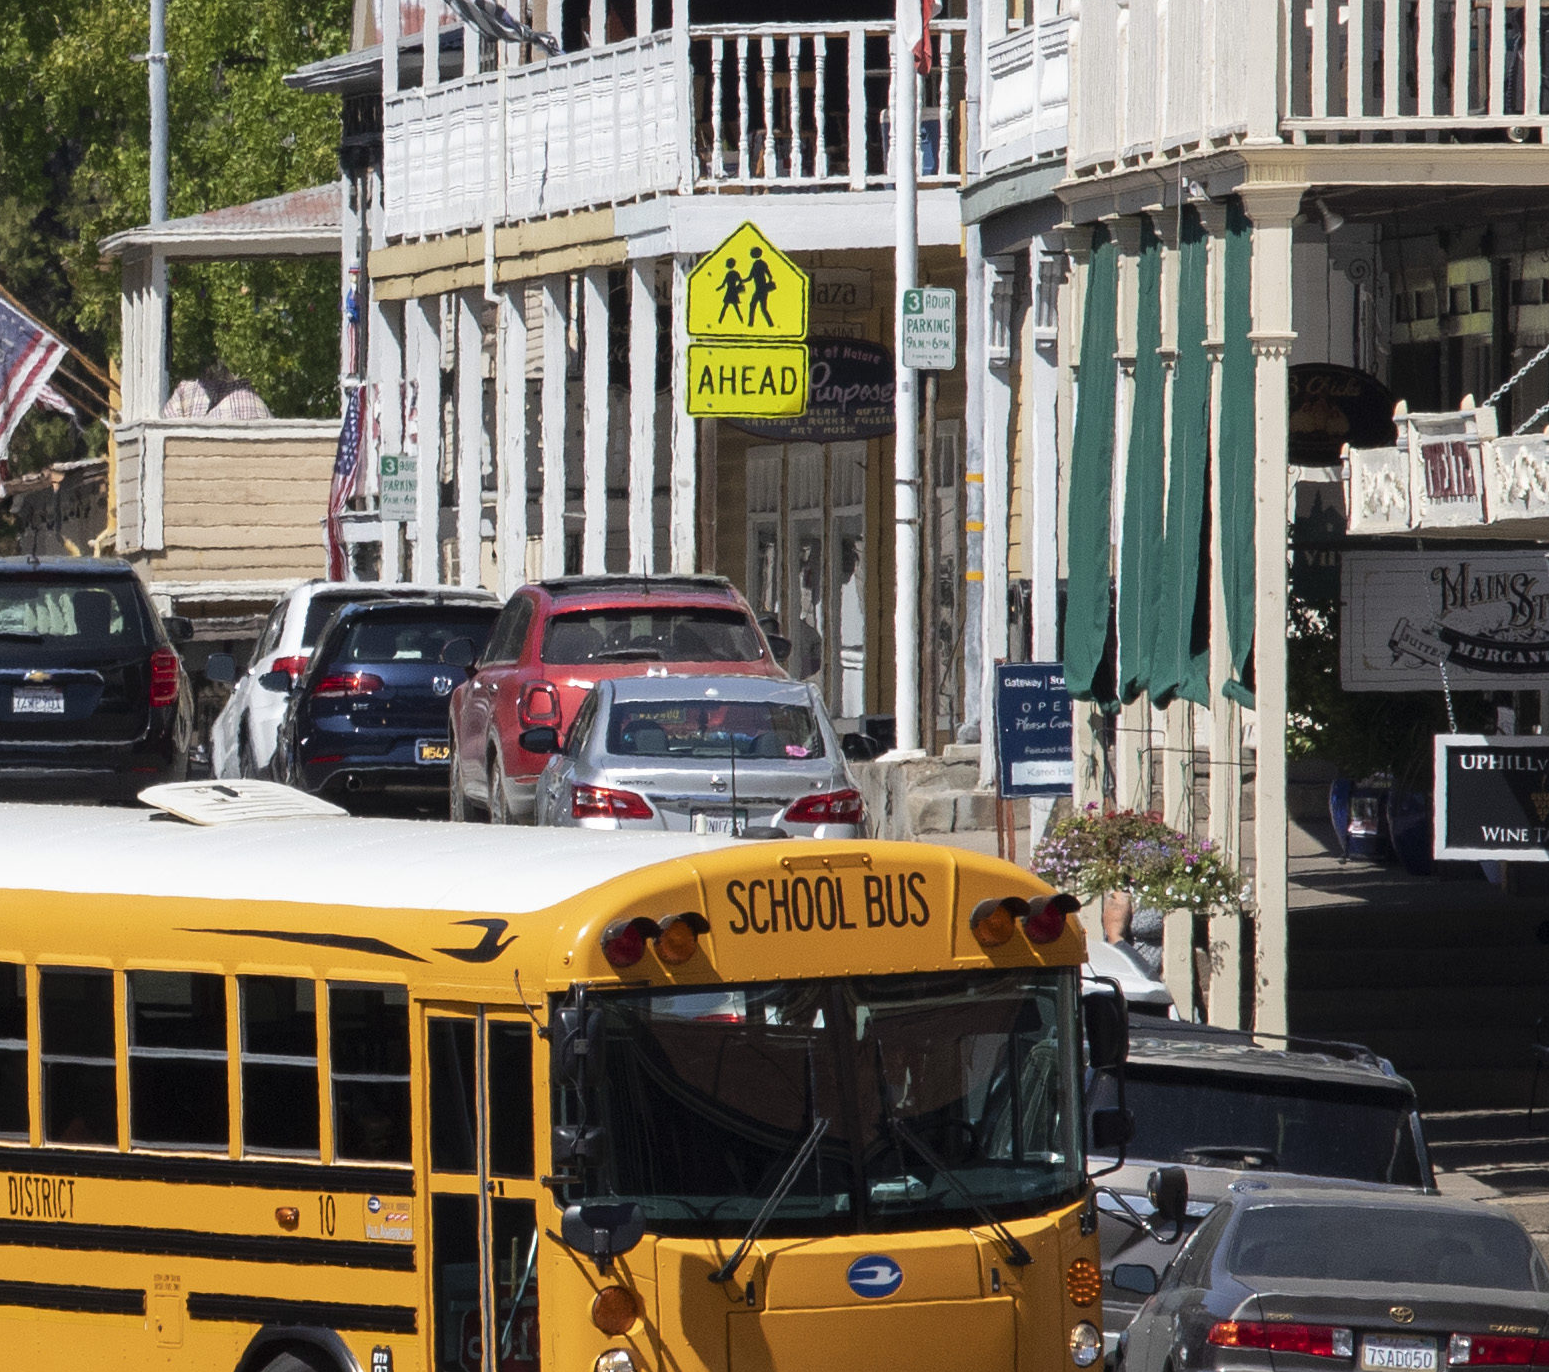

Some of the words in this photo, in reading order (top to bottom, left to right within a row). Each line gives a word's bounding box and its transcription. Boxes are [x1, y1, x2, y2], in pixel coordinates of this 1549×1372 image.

[811, 274, 856, 305] laza
[908, 293, 920, 311] 3
[926, 295, 950, 309] HOUR
[907, 319, 950, 333] PARKING
[697, 366, 798, 395] AHEAD
[855, 416, 895, 425] FOSSIL
[385, 459, 395, 472] 3
[384, 479, 417, 492] PARKIN
[1431, 562, 1510, 617] MAIN
[1004, 678, 1042, 688] Gateway
[1016, 717, 1047, 731] Please
[1049, 716, 1072, 729] Com
[1482, 826, 1529, 842] WINE
[726, 876, 857, 935] SCHOOL
[863, 872, 930, 928] BUS
[8, 1176, 76, 1219] DISTRICT
[319, 1194, 336, 1237] 10
[1367, 1348, 1433, 1369] 7SAD050
